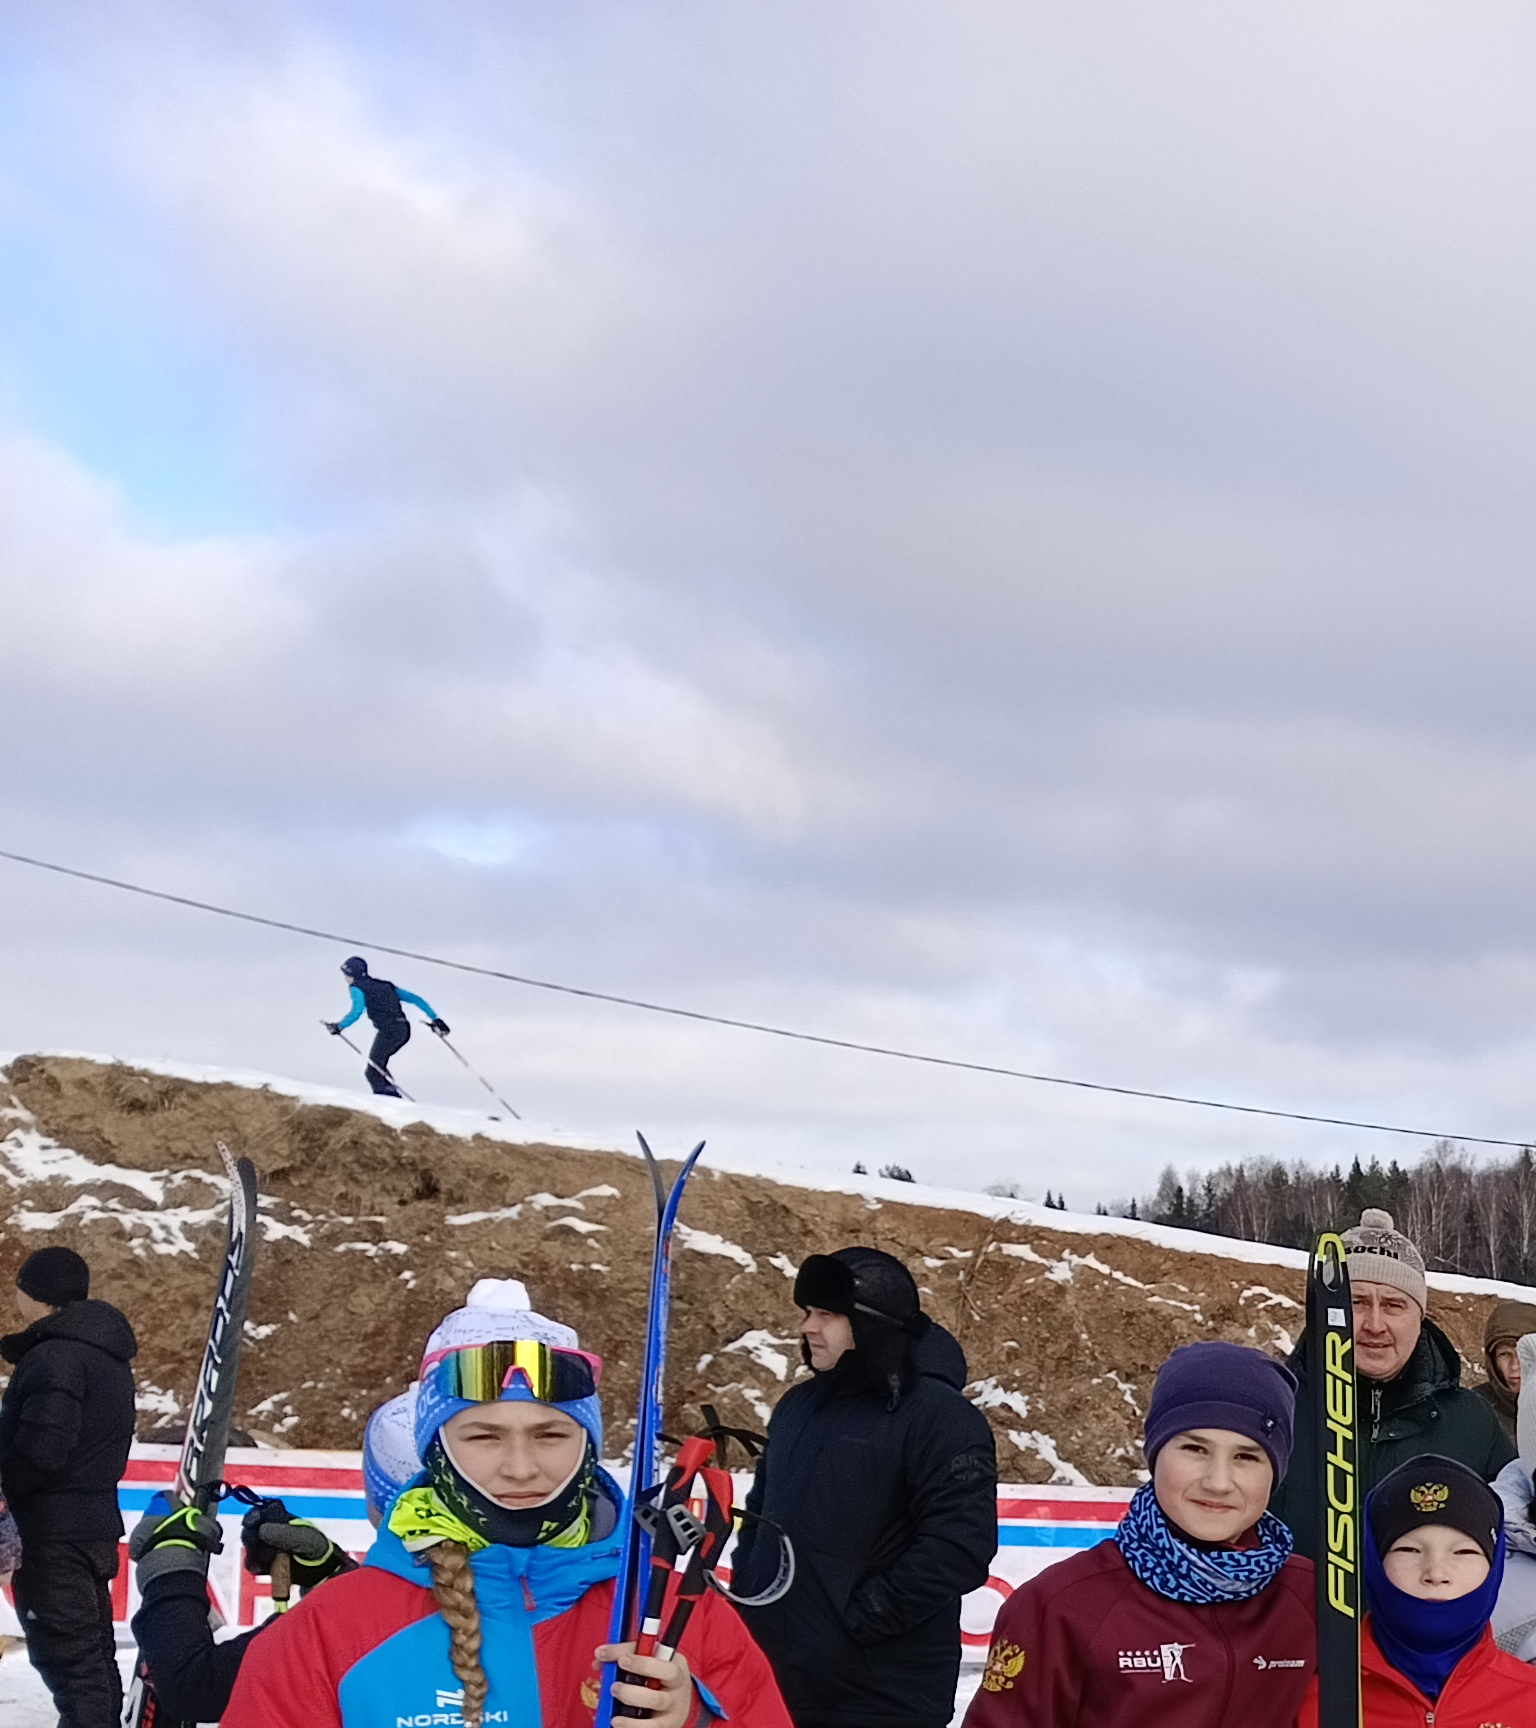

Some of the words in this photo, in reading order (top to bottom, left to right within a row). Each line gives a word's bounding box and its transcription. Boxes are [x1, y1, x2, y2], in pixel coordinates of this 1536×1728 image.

[1326, 1331, 1355, 1619] FISCHER
[1119, 1656, 1161, 1669] RBU
[396, 1710, 508, 1728] NORDKI
